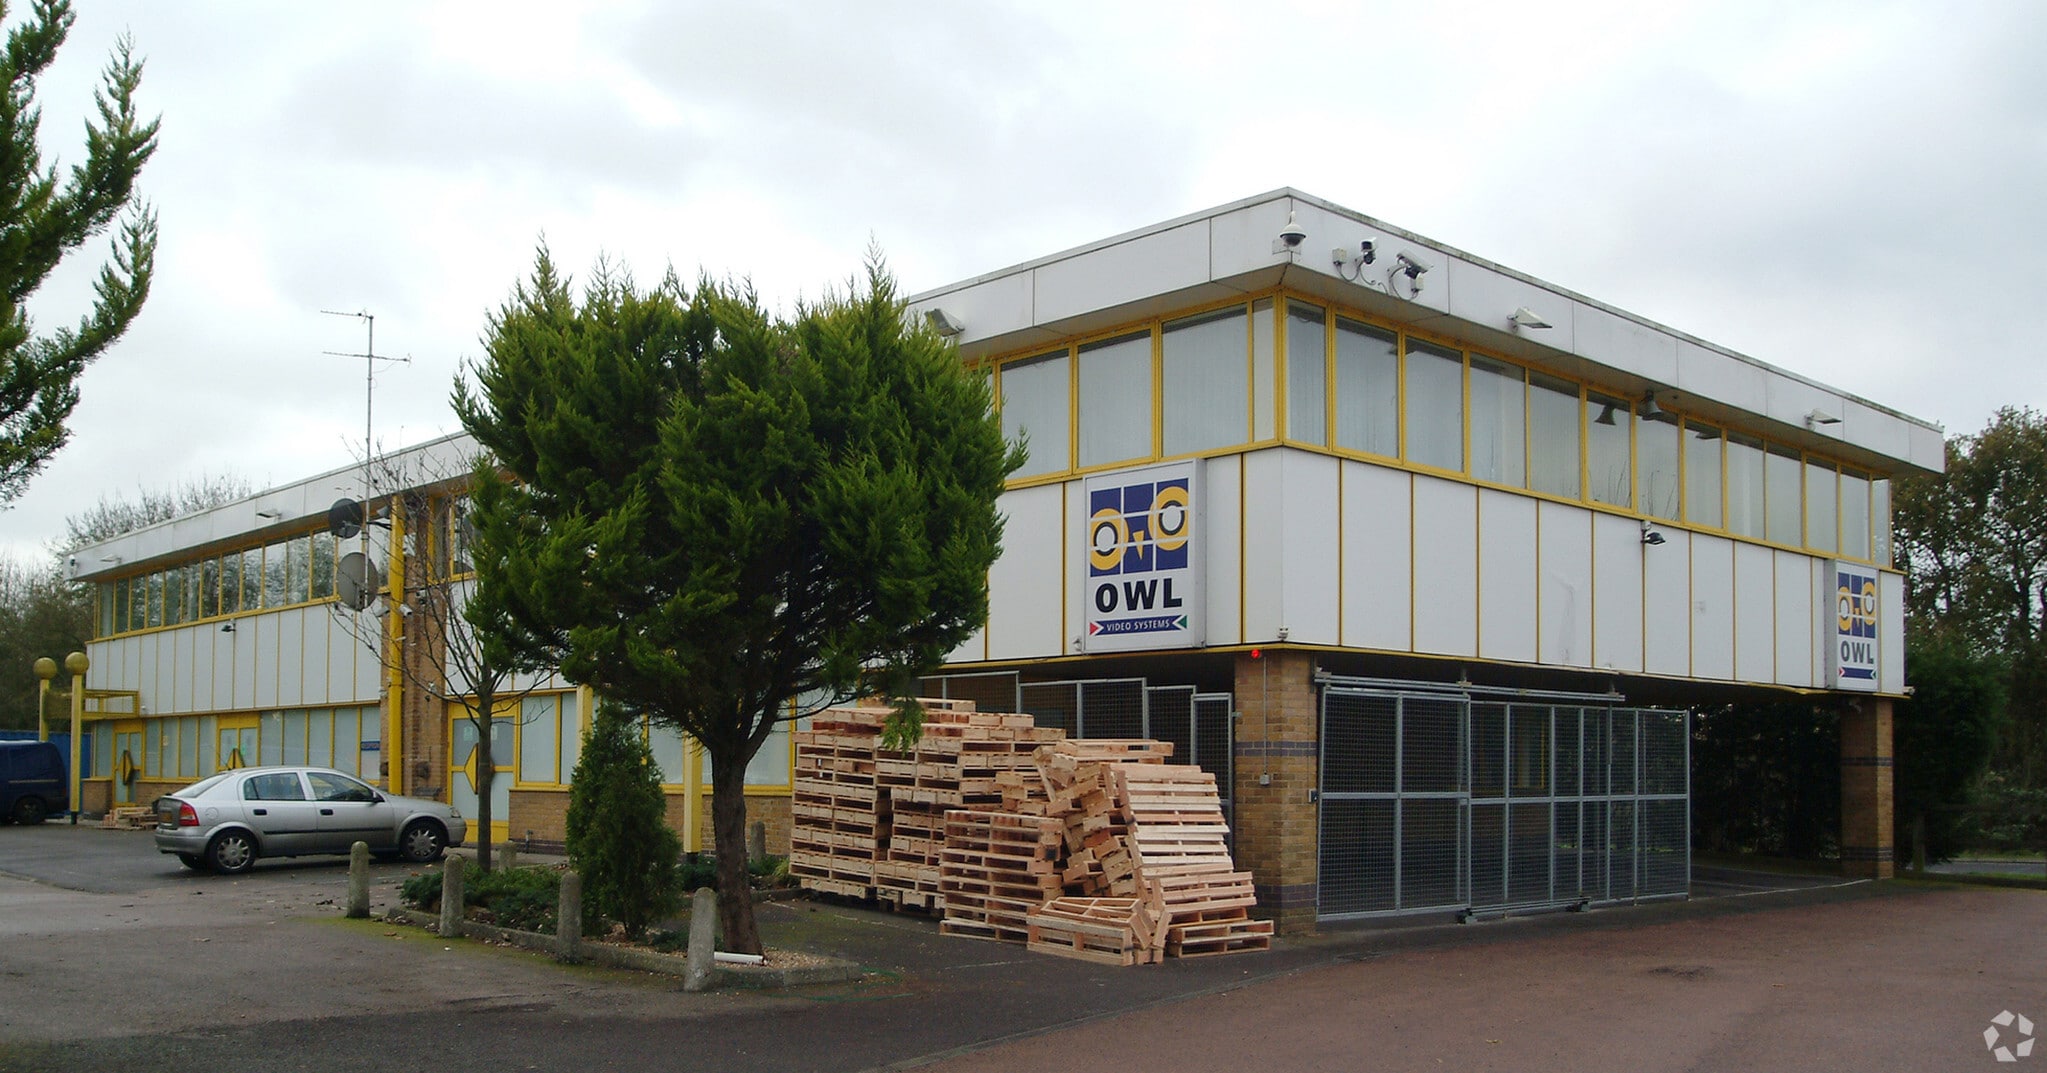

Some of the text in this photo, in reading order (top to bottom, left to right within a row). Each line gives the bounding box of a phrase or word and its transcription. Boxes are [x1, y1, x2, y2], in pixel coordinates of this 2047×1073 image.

[1095, 577, 1182, 613] OWL
[1106, 619, 1170, 632] VIDEO SYSTEMS
[1841, 640, 1875, 665] OWL
